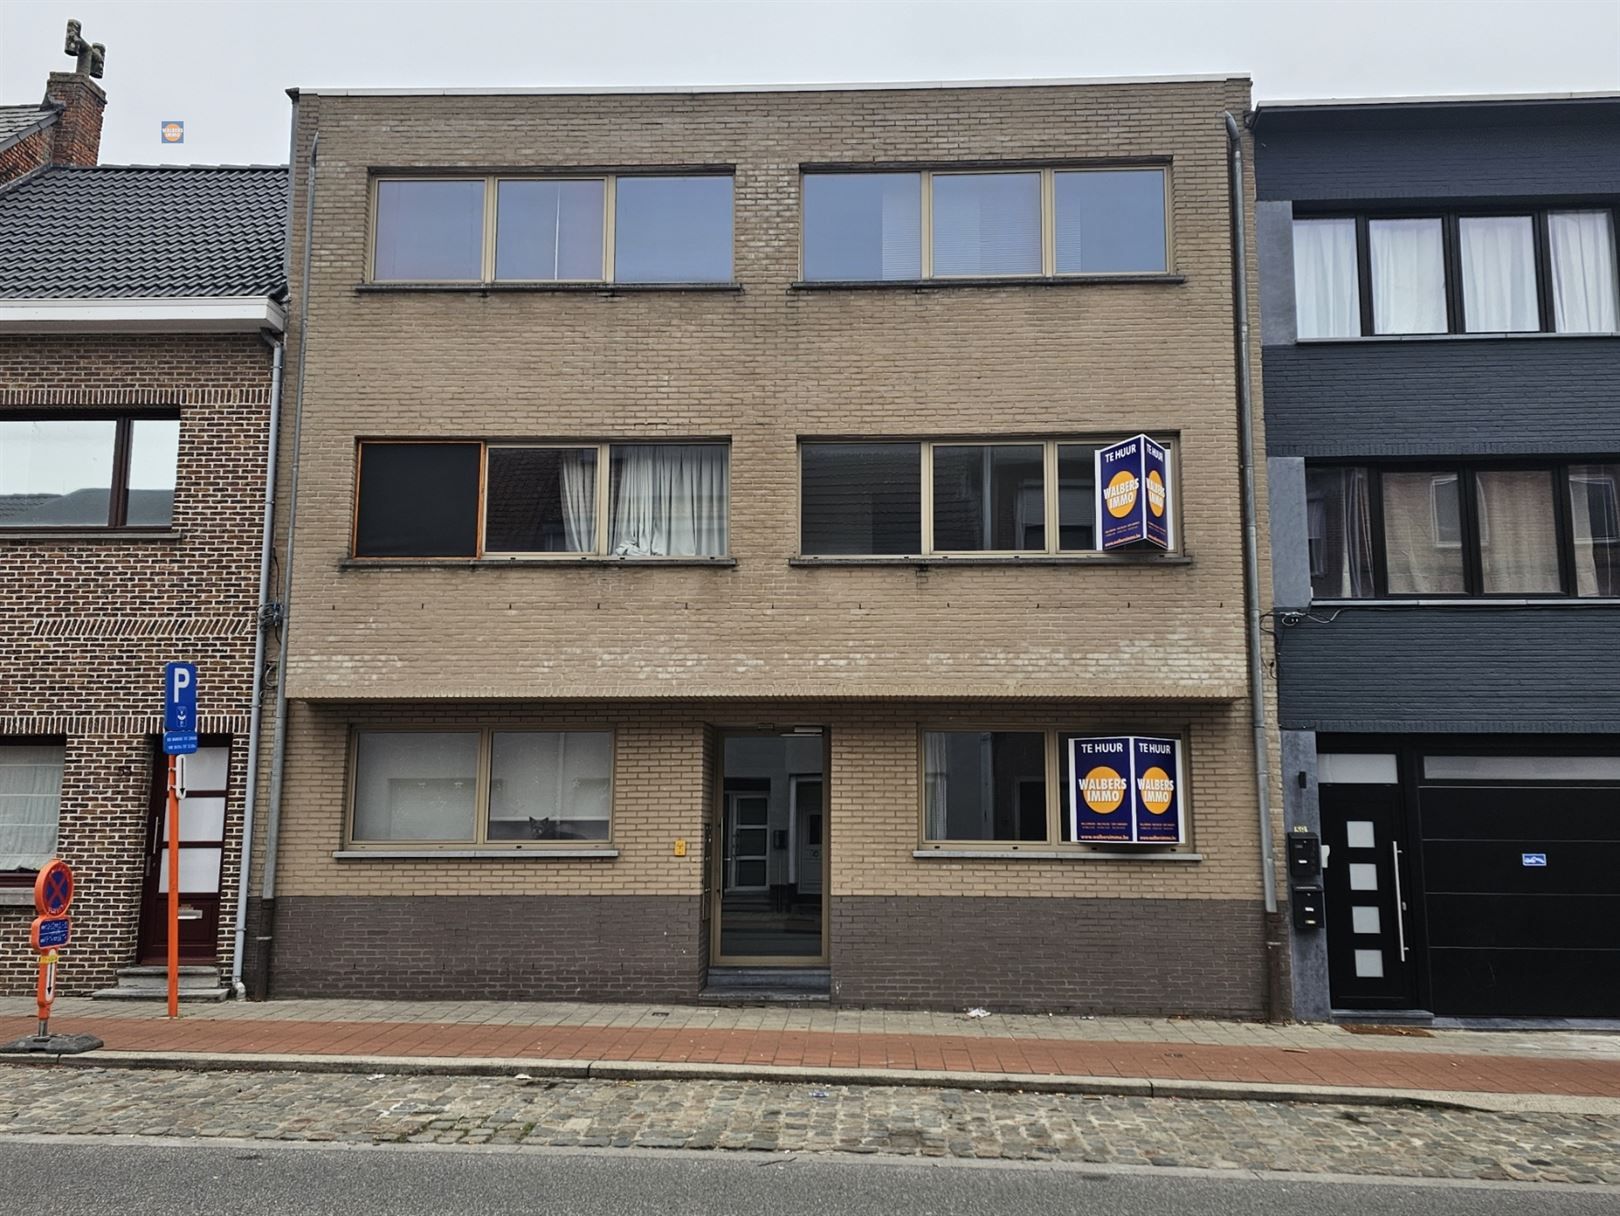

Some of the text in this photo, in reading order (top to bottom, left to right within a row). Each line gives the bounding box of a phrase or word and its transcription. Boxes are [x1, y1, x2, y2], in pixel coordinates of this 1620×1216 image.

[1105, 444, 1137, 463] TE HUUR
[1146, 443, 1152, 455] TE
[1103, 478, 1139, 500] WALBERS
[1110, 493, 1134, 509] IMMO
[174, 667, 190, 703] P
[1081, 743, 1123, 754] TE HUUR
[1139, 743, 1171, 754] TE HUUR
[1079, 778, 1127, 791] WALBERS
[1137, 778, 1174, 791] WALBERS
[1087, 790, 1120, 802] IMMO
[1144, 791, 1169, 803] IMMO
